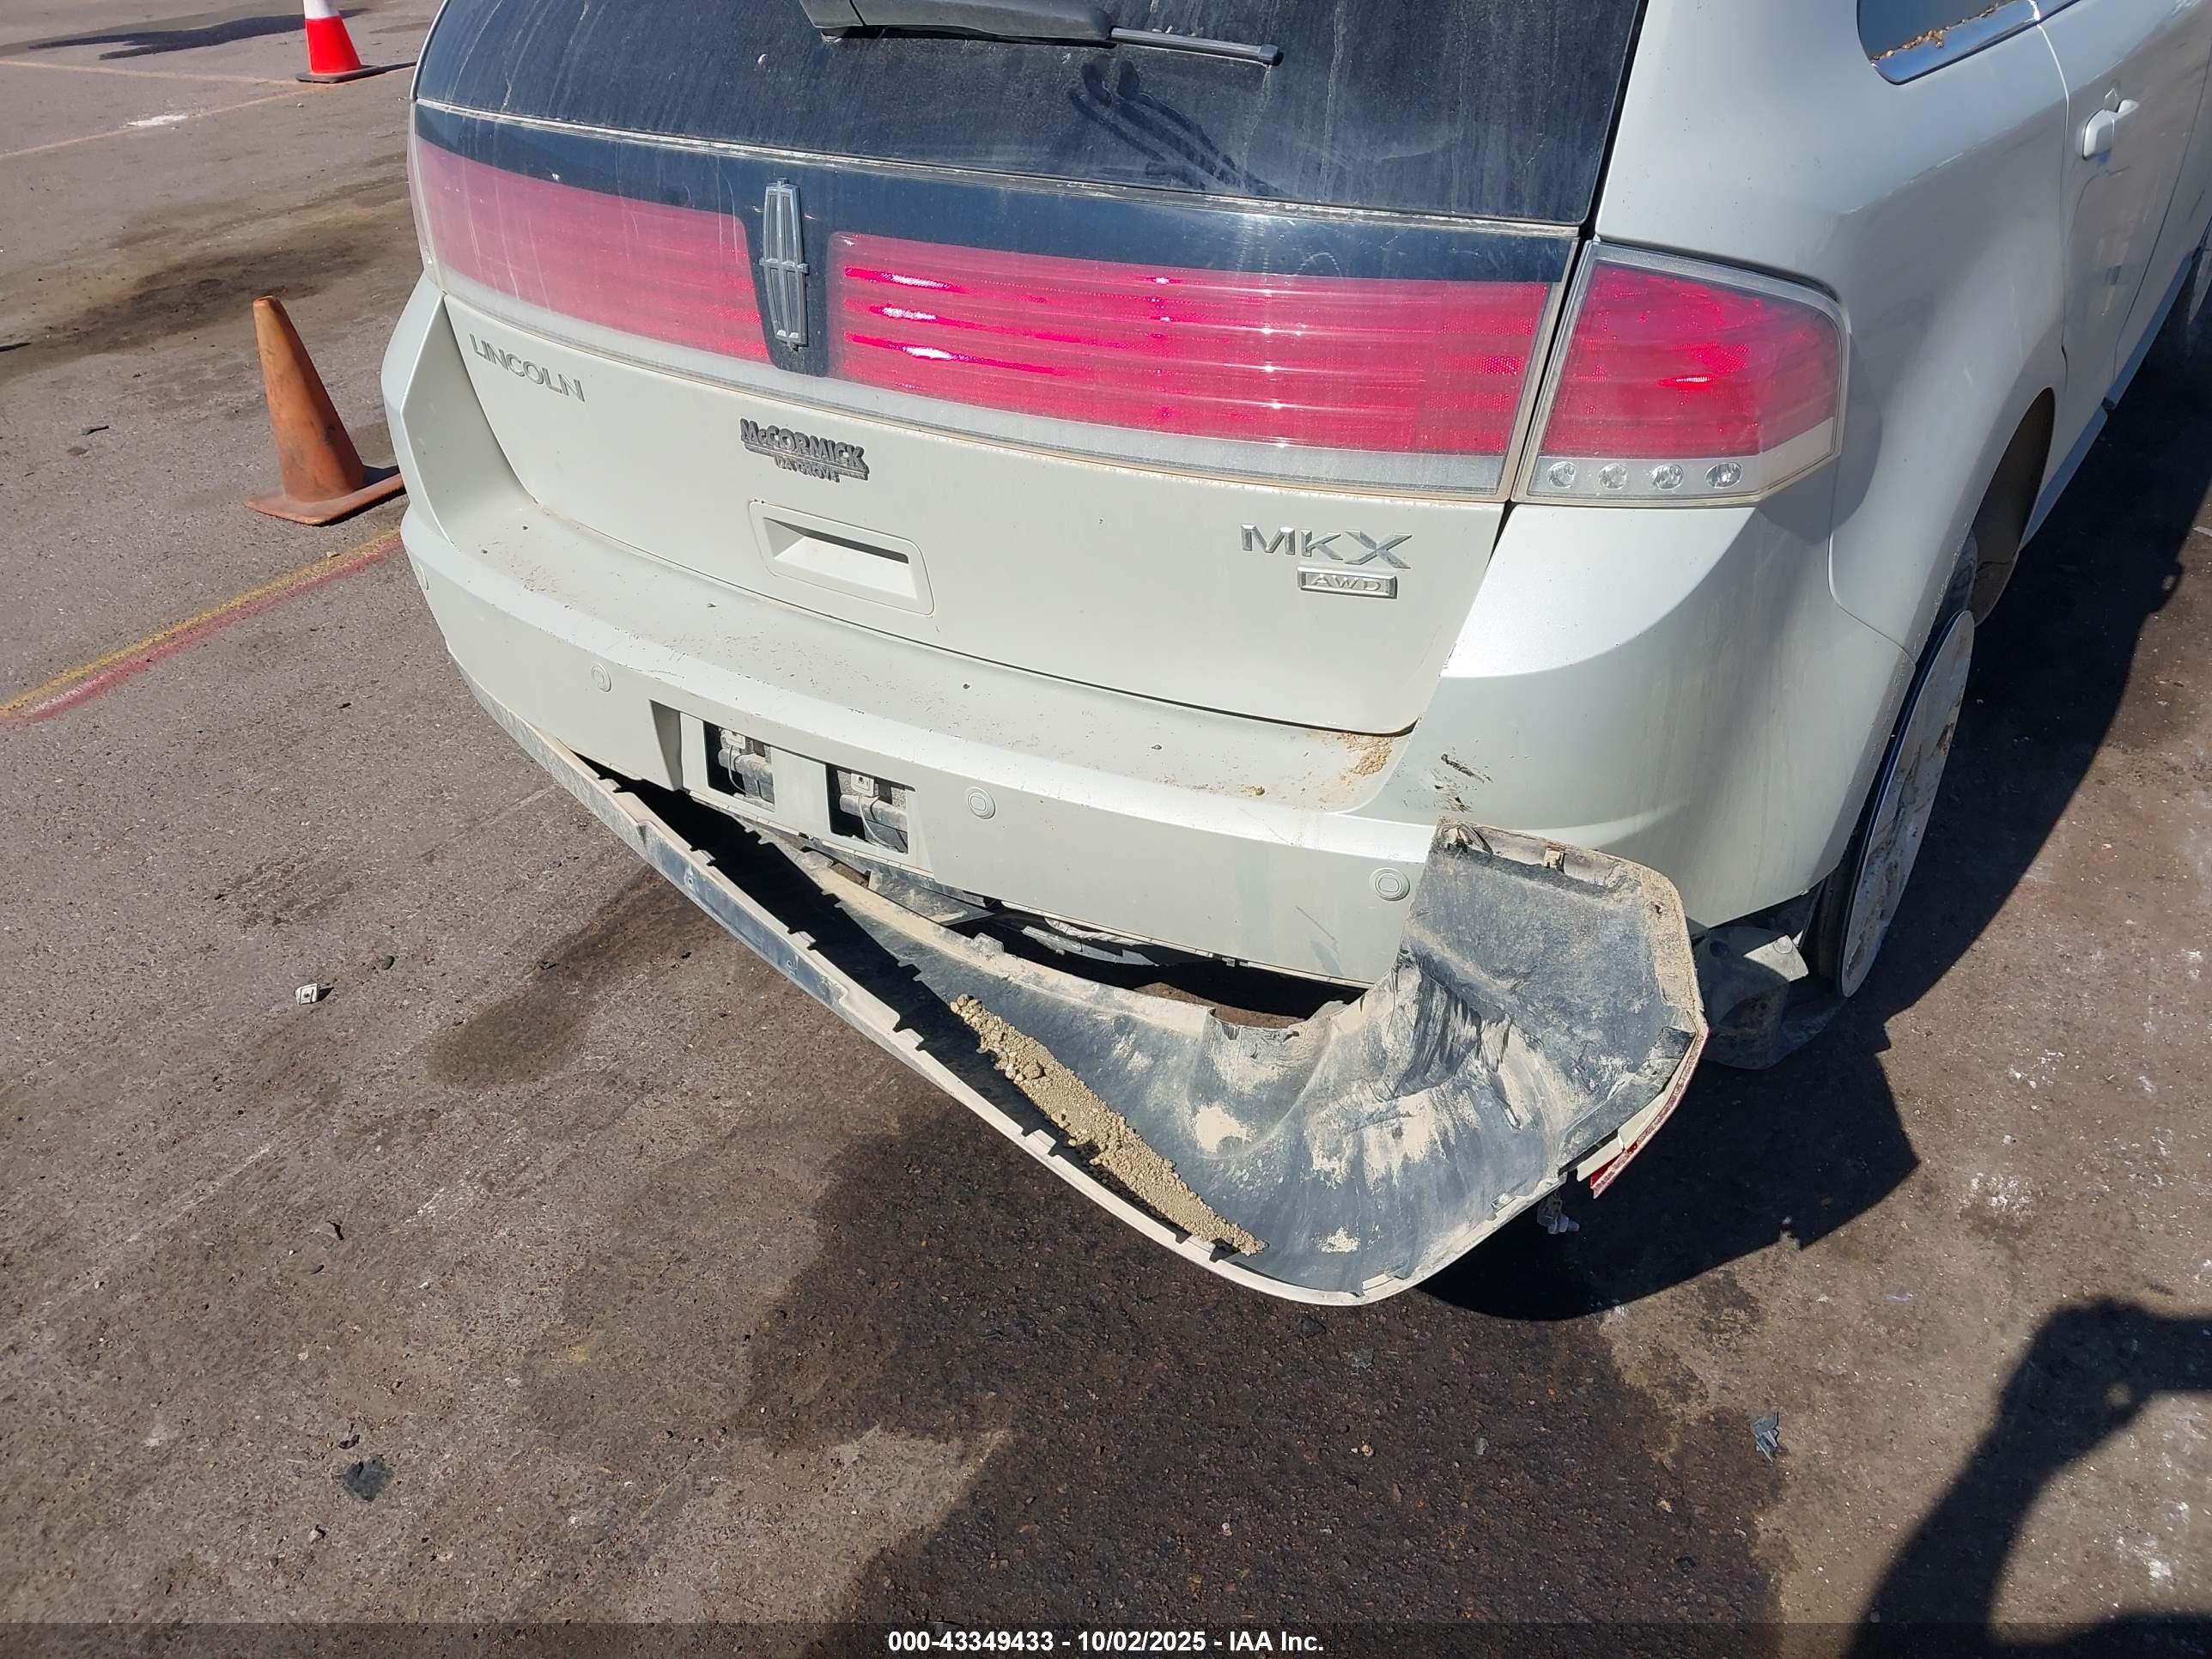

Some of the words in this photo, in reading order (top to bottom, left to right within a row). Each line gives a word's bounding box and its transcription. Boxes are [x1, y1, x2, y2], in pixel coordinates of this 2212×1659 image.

[470, 333, 586, 403] LINCOLN
[1240, 523, 1413, 569] MKX
[1310, 573, 1382, 592] AWD
